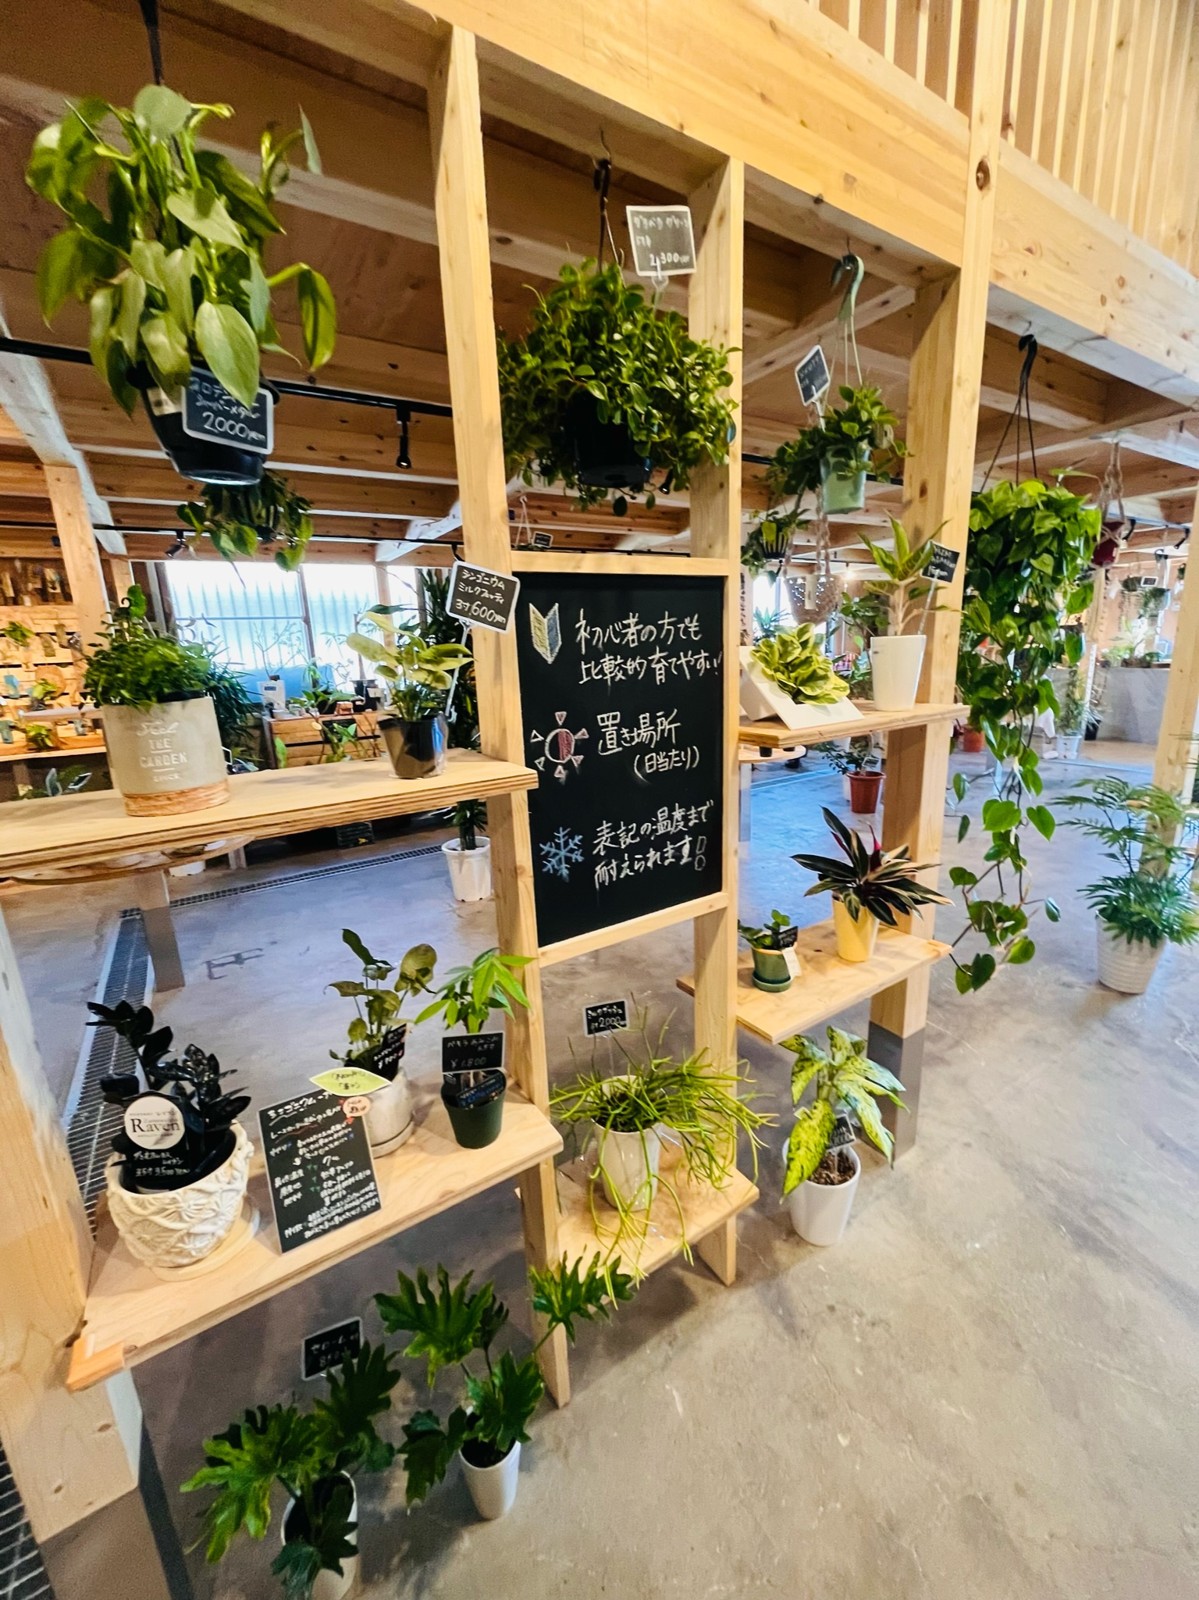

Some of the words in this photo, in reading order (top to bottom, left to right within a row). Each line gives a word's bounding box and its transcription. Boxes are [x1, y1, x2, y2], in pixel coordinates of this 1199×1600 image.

[461, 568, 505, 591] シンゴニウム
[575, 608, 702, 655] 初心者の方でも
[597, 708, 682, 756] 置き場所
[139, 751, 188, 768] GARDEN
[634, 746, 700, 780] (日当たり)
[592, 800, 715, 856] 表記の温度まで
[130, 1118, 181, 1133] Raven
